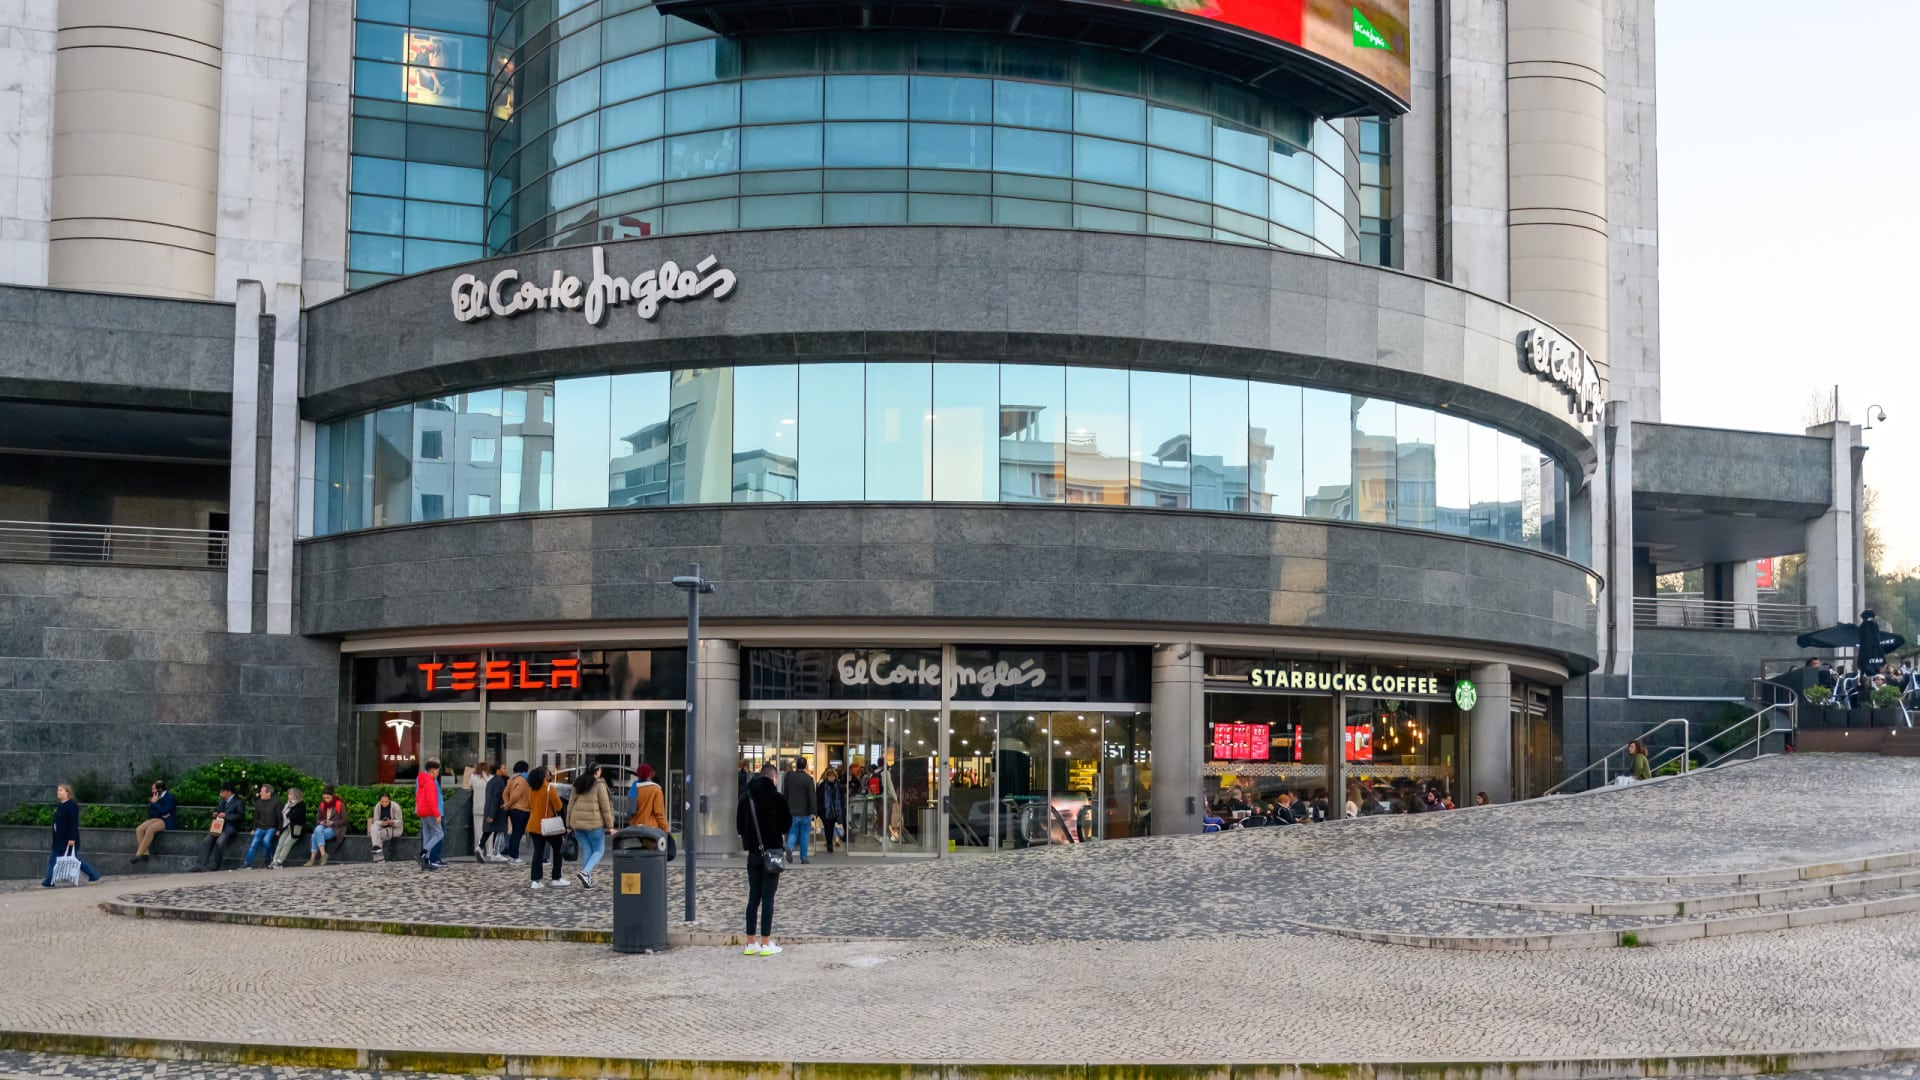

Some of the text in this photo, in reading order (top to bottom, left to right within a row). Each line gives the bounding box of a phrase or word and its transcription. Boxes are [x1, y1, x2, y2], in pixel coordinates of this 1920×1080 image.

[451, 246, 738, 326] El Corte Inglés
[1529, 328, 1550, 374] El
[417, 659, 581, 691] TESLA
[837, 653, 869, 686] El
[870, 652, 941, 686] Corte
[1251, 668, 1439, 694] STARBUCKS COFFEE
[581, 741, 608, 749] DESIGN
